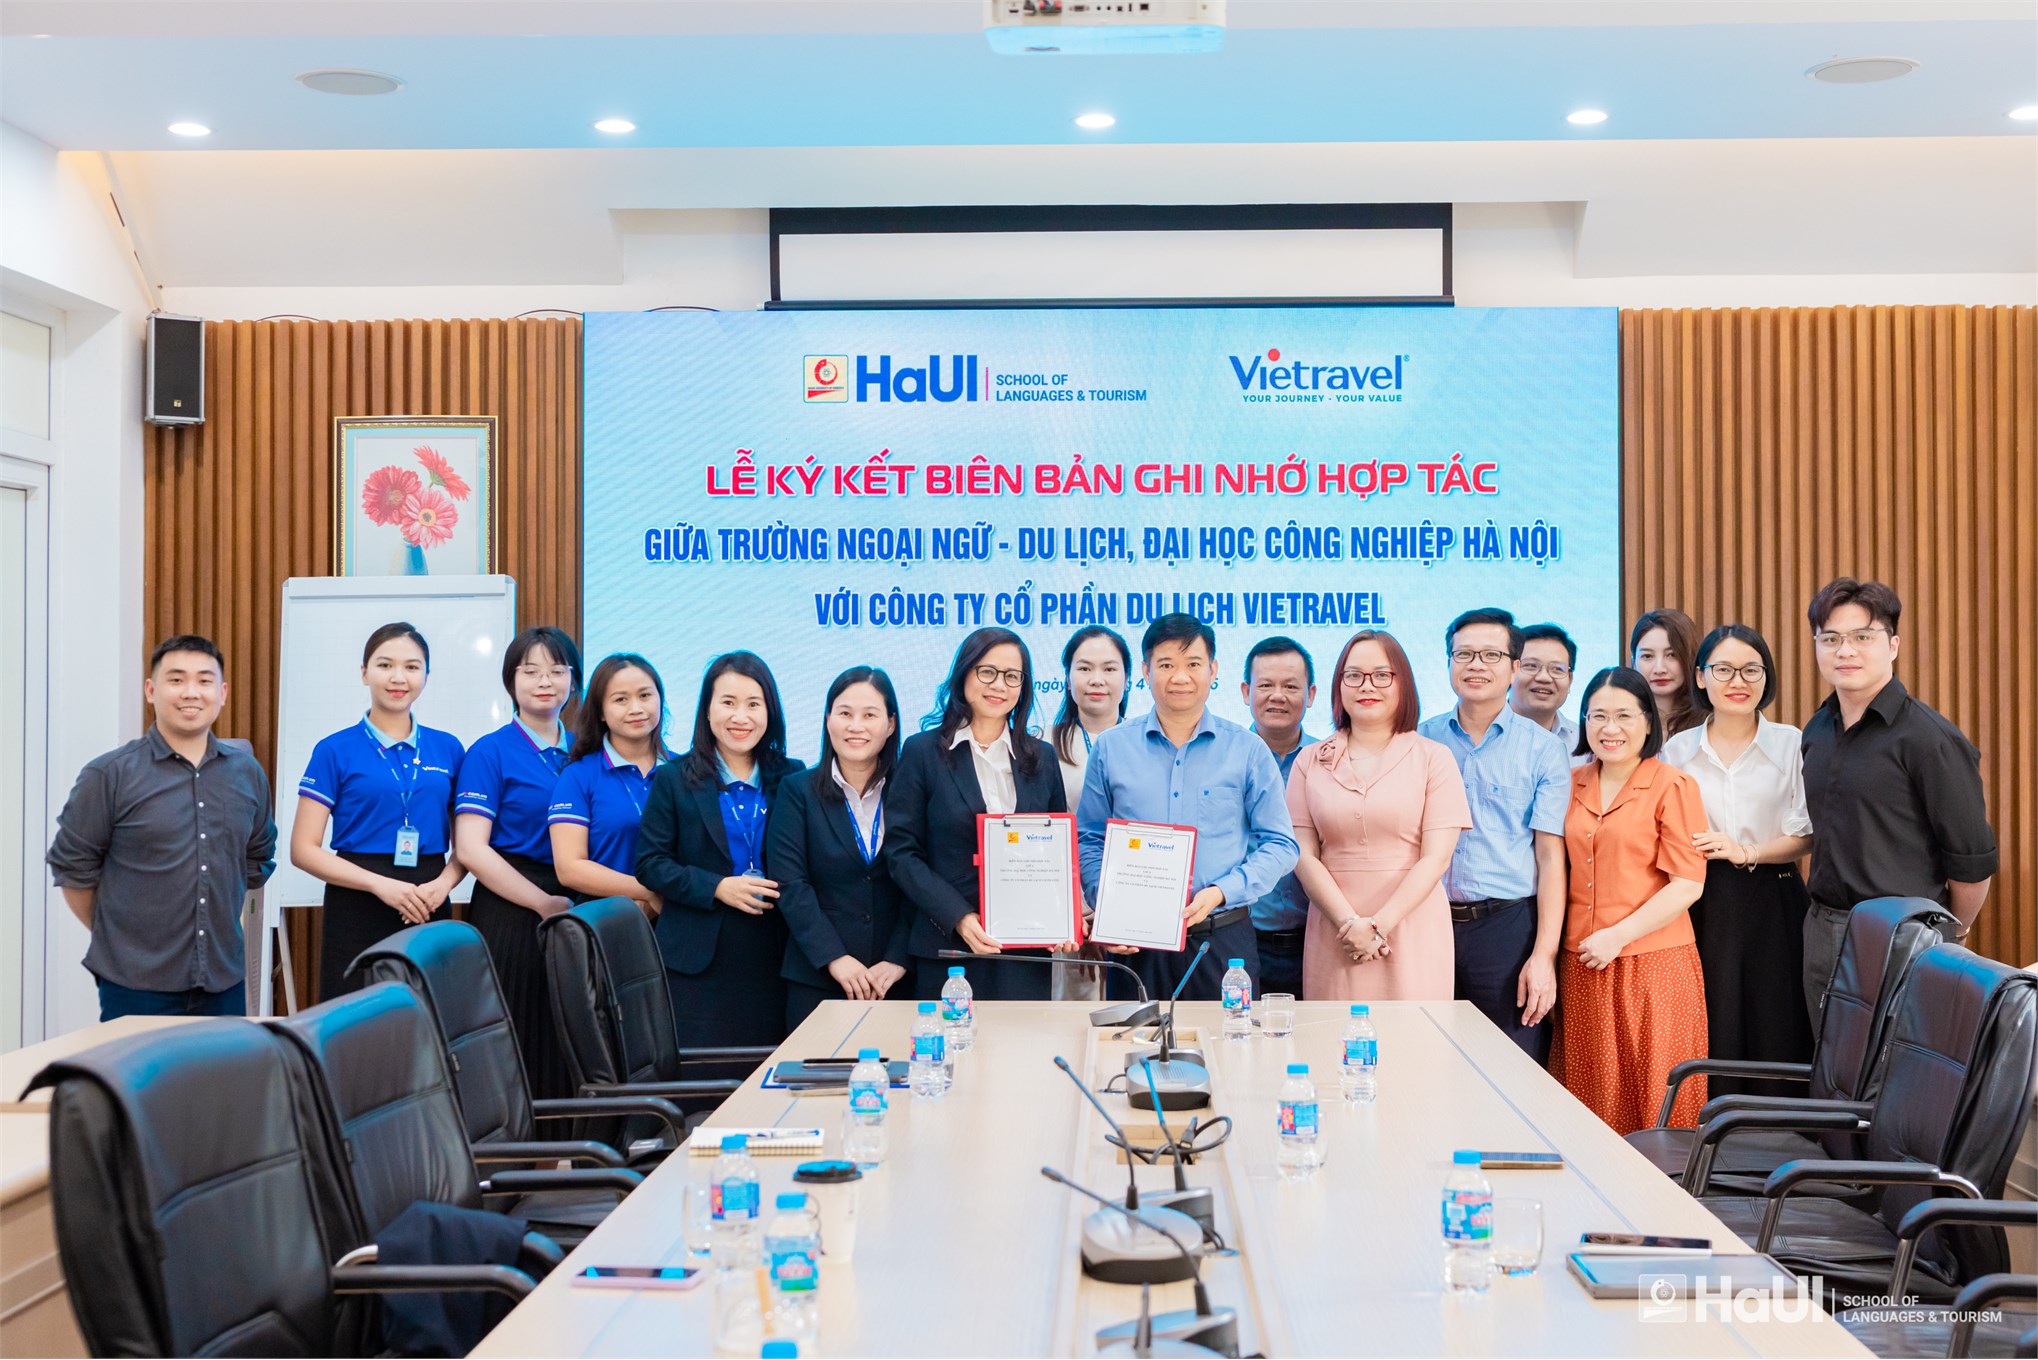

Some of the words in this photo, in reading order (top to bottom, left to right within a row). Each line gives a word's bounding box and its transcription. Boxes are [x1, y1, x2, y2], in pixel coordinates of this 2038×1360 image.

[857, 355, 977, 402] HaUI
[996, 374, 1049, 386] SCHOOL
[1052, 374, 1069, 386] OF
[996, 389, 1074, 402] LANGUAGES
[1076, 389, 1086, 402] &
[1088, 389, 1147, 402] TOURISM
[1242, 394, 1272, 403] YOUR
[1275, 394, 1324, 403] JOURNEY
[1336, 394, 1365, 403] YOUR
[1368, 394, 1402, 403] VALUE
[707, 447, 756, 495] LỄ
[767, 455, 824, 495] KÝ
[834, 447, 916, 495] KẾT
[926, 455, 1022, 494] BIÊN
[1035, 453, 1122, 494] BẢN
[1134, 464, 1202, 493] GHI
[1215, 453, 1307, 493] NHỚ
[1318, 459, 1407, 500] HỢP
[1417, 453, 1497, 493] TÁC
[644, 523, 710, 561] GIỮA
[718, 520, 828, 561] TRƯỜNG
[837, 527, 922, 568] NGOẠI
[932, 522, 993, 560] NGỮ
[1018, 527, 1055, 560] DU
[1065, 528, 1134, 567] LỊCH,
[1143, 527, 1189, 566] ĐẠI
[1199, 527, 1255, 566] HỌC
[1264, 519, 1341, 559] CÔNG
[1351, 519, 1454, 566] NGHIỆP
[1463, 519, 1501, 559] HÀ
[1510, 519, 1558, 566] NỘI
[814, 586, 859, 626] VỚI
[869, 586, 945, 626] CÔNG
[953, 593, 986, 625] TY
[995, 580, 1033, 626] CỔ
[1041, 581, 1117, 625] PHẦN
[1126, 592, 1163, 625] DU
[1243, 592, 1386, 624] VIETRAVEL
[1033, 677, 1065, 694] ngày
